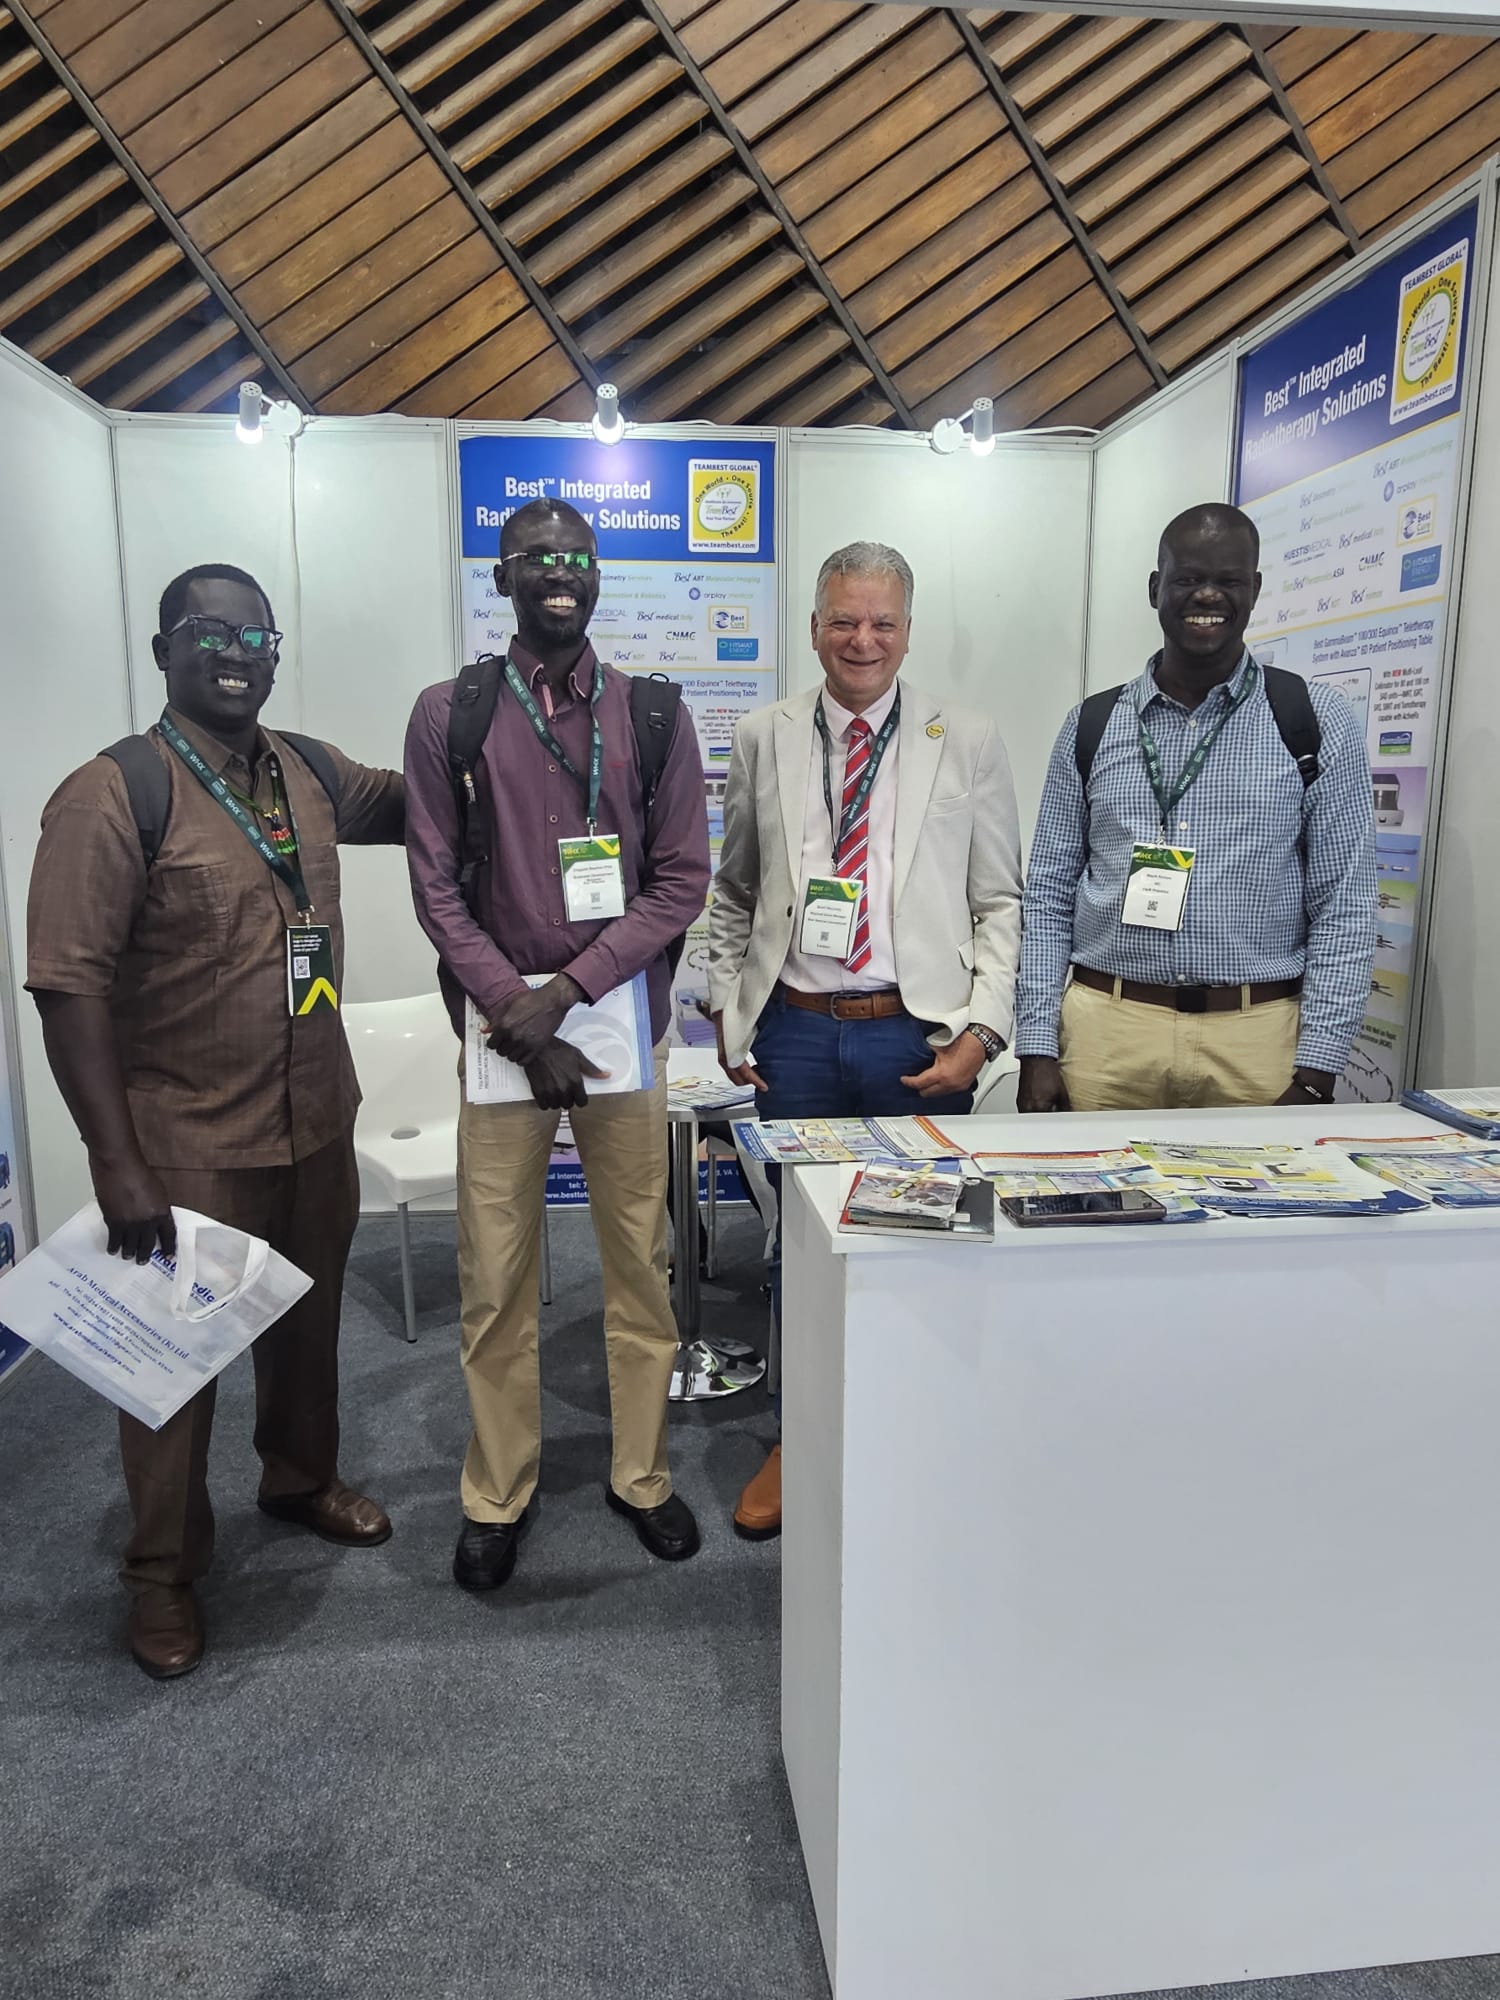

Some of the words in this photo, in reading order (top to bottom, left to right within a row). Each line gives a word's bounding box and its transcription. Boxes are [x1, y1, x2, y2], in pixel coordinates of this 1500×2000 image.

[1404, 265, 1436, 292] TEAMBEST
[1438, 277, 1451, 288] One
[1450, 281, 1460, 327] Source
[1401, 319, 1413, 344] One
[1411, 288, 1430, 321] World
[1298, 335, 1366, 398] Integrated
[1420, 372, 1434, 389] The
[1392, 383, 1453, 417] www.teambest.com
[1244, 406, 1320, 465] Radiotherapy
[1321, 373, 1387, 426] Solutions
[1373, 457, 1388, 478] Best
[732, 474, 745, 484] One
[560, 479, 651, 502] Integrated
[695, 490, 706, 503] One
[704, 476, 723, 490] World
[599, 510, 680, 530] Solutions
[1417, 511, 1431, 523] Best
[721, 530, 733, 538] The
[1339, 533, 1355, 550] Best
[1353, 529, 1373, 544] medical
[472, 569, 490, 579] Best
[674, 572, 692, 582] Best
[486, 588, 500, 598] Bes
[1350, 587, 1366, 605] Best
[473, 610, 492, 619] Best
[637, 611, 656, 621] Best
[1404, 619, 1434, 632] Teletherapy
[487, 630, 504, 640] Best
[666, 631, 696, 640] CNMC
[1369, 643, 1387, 654] Patient
[1388, 638, 1417, 652] Positioning
[1419, 634, 1433, 645] Table
[614, 651, 632, 661] Best
[659, 651, 677, 661] Best
[66, 1264, 89, 1282] Arab
[84, 1279, 121, 1307] Medical
[115, 1303, 164, 1341] Accessories
[160, 1337, 176, 1350] (K)
[173, 1346, 190, 1360] Ltd
